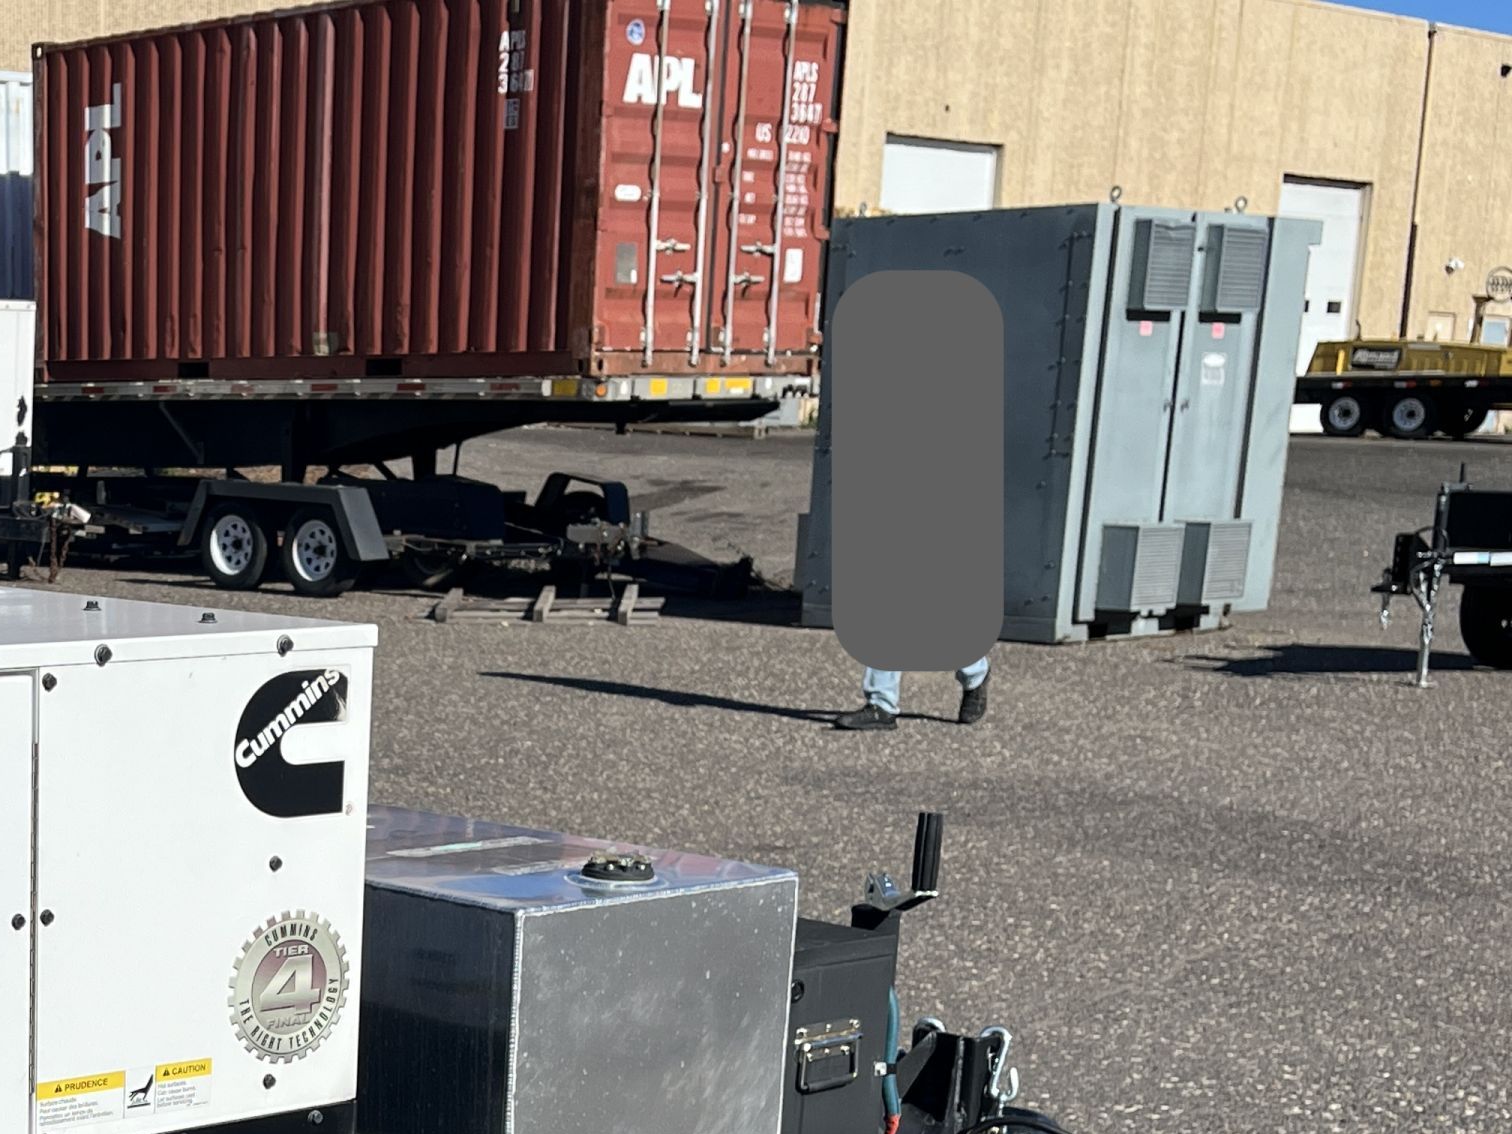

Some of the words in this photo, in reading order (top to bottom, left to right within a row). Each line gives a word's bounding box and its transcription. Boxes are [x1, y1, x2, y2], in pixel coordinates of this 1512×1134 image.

[623, 52, 703, 108] APL
[793, 61, 819, 83] APLS
[792, 81, 816, 103] 287
[84, 83, 121, 239] APL
[235, 668, 340, 768] Cummins
[265, 922, 318, 947] CUMMINS
[273, 944, 309, 957] TIER
[259, 954, 322, 1014] 4
[239, 999, 254, 1025] THE
[250, 1025, 282, 1051] RIGHT
[288, 978, 339, 1049] TECHNOLOGY
[267, 1013, 311, 1029] FINAL
[171, 1064, 206, 1075] CAUTION
[64, 1078, 108, 1091] PRUDENCE
